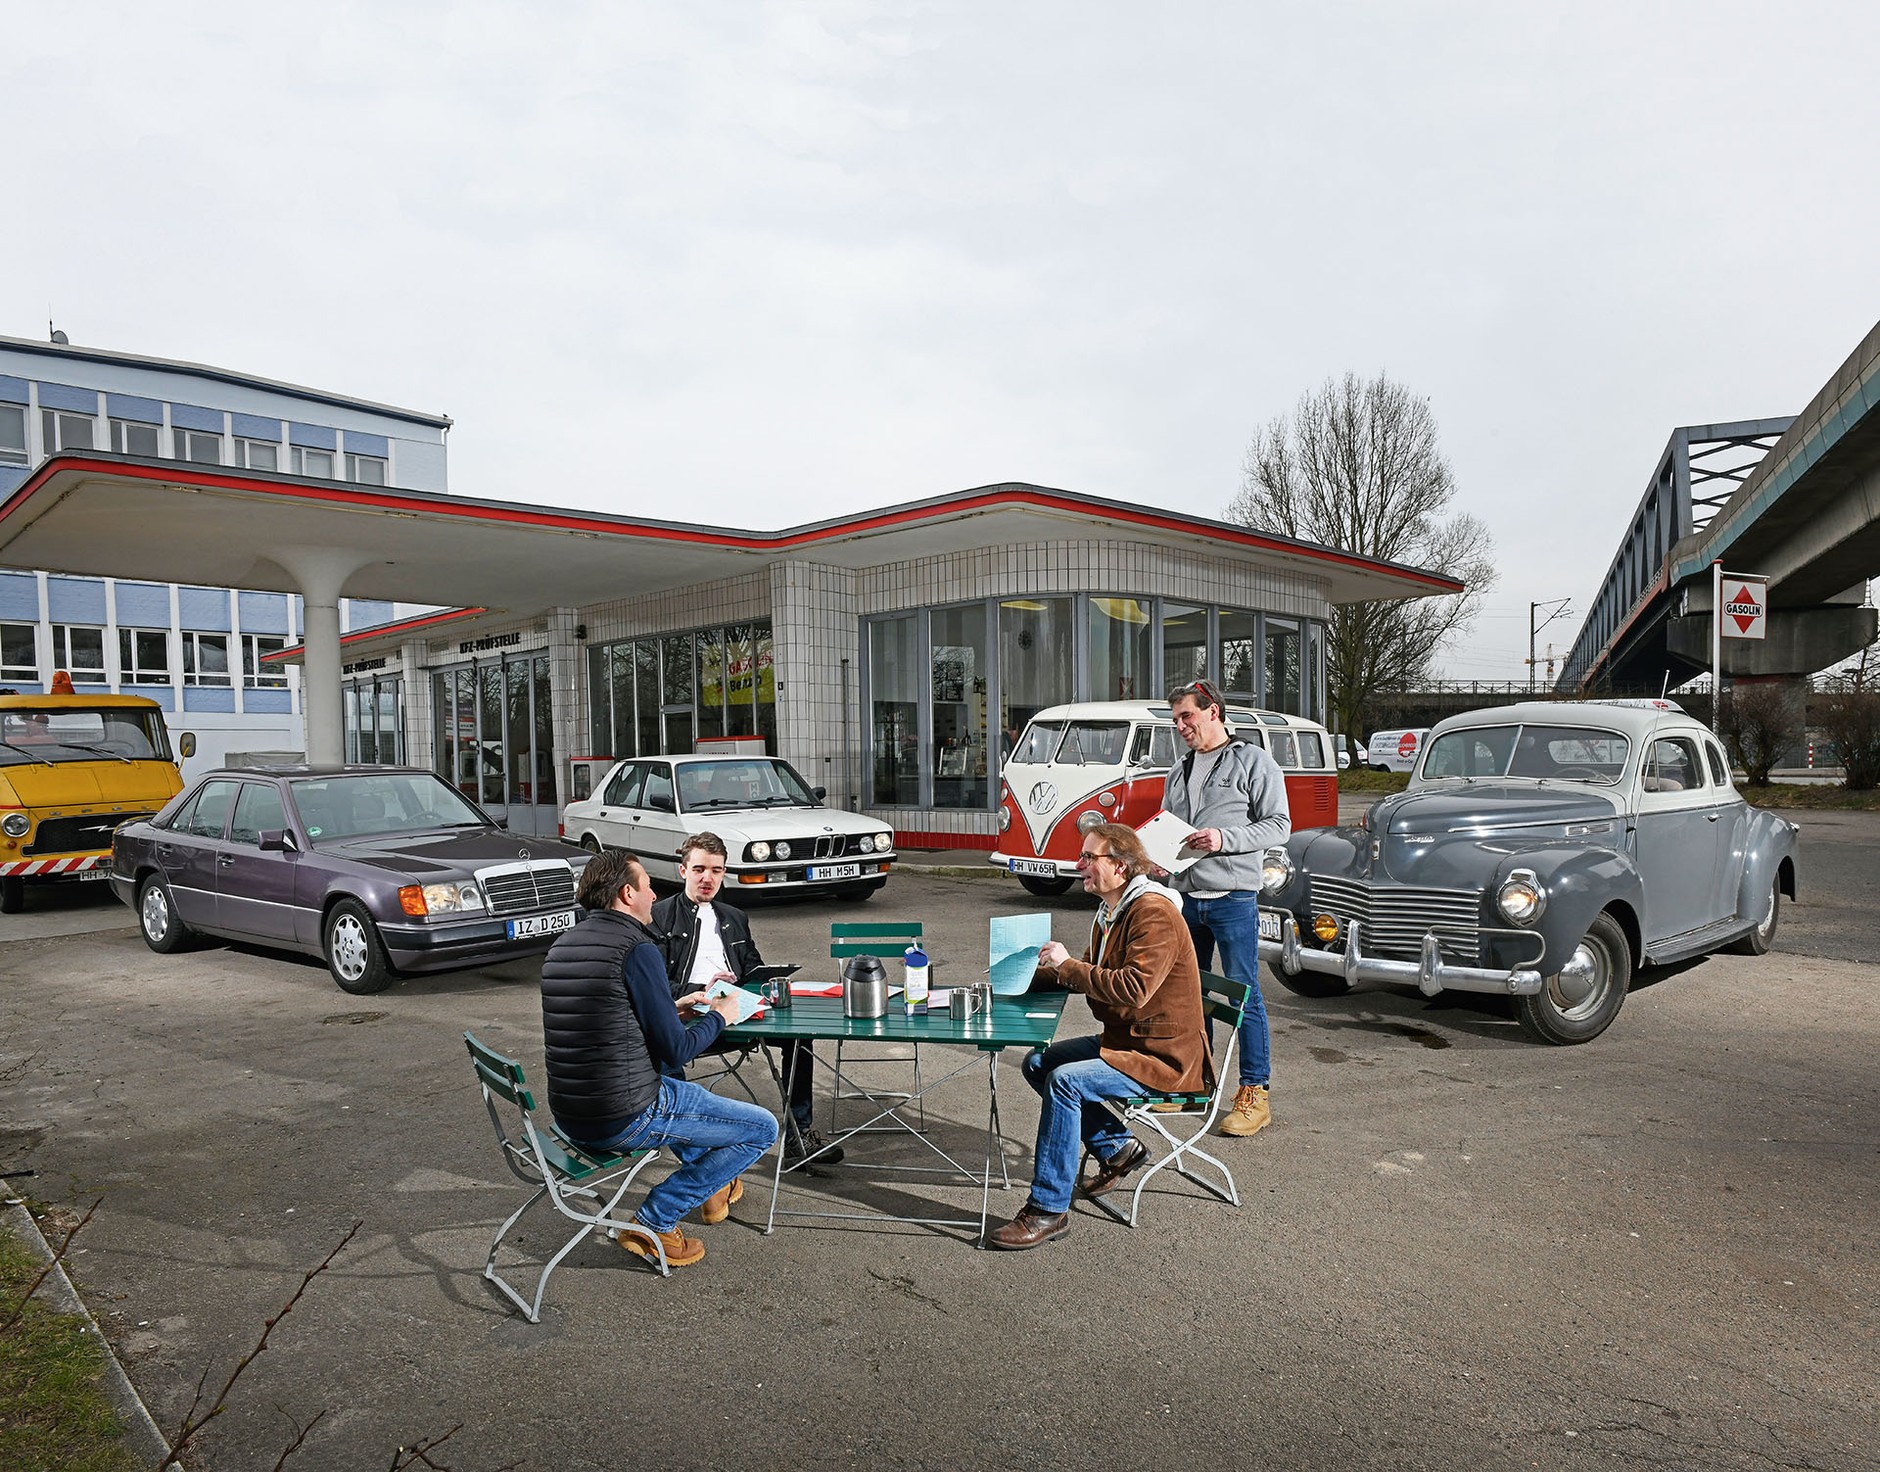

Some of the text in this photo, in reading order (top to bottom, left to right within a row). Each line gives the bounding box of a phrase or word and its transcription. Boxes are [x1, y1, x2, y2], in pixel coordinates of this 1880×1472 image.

[1726, 604, 1760, 615] GASOLIN
[460, 632, 520, 654] KFZ-PRÜFSTELLE
[730, 675, 762, 692] Benzn
[818, 867, 832, 878] HH
[518, 920, 533, 935] IZ
[541, 917, 548, 931] D
[551, 914, 570, 930] 250
